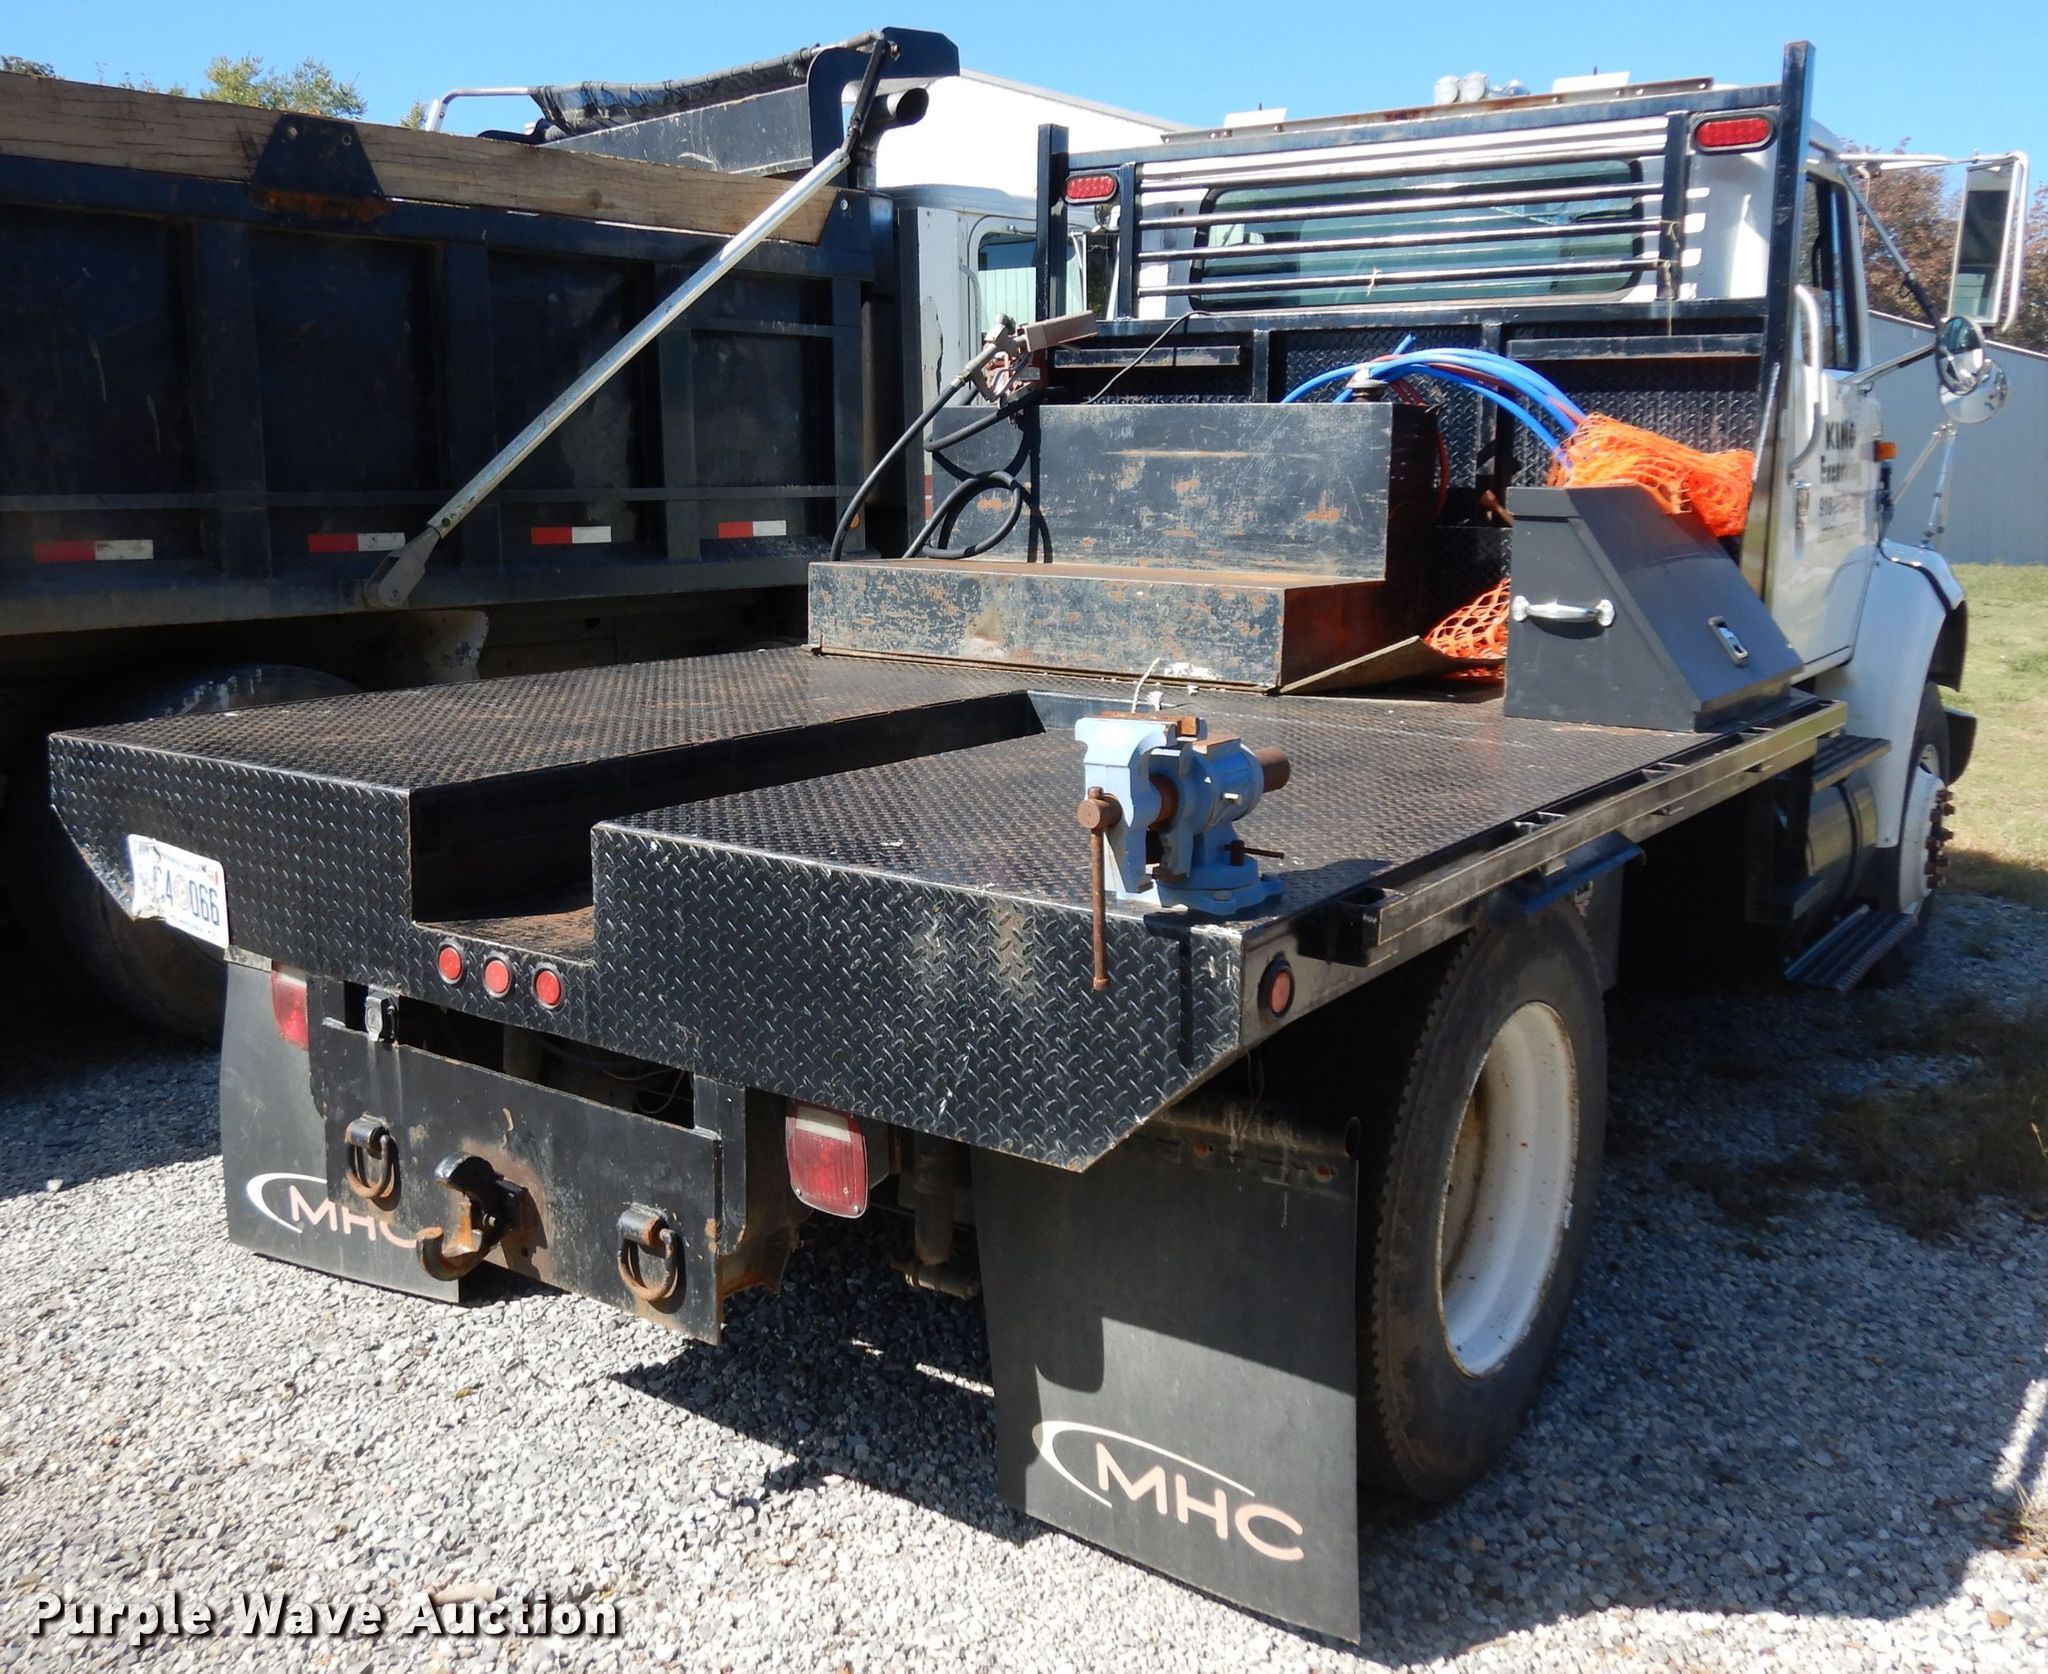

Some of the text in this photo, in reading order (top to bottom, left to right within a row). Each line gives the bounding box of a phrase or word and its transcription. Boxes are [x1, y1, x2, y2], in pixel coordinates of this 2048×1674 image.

[1825, 420, 1857, 450] KING
[189, 880, 220, 926] 066
[1095, 1442, 1305, 1561] MHC
